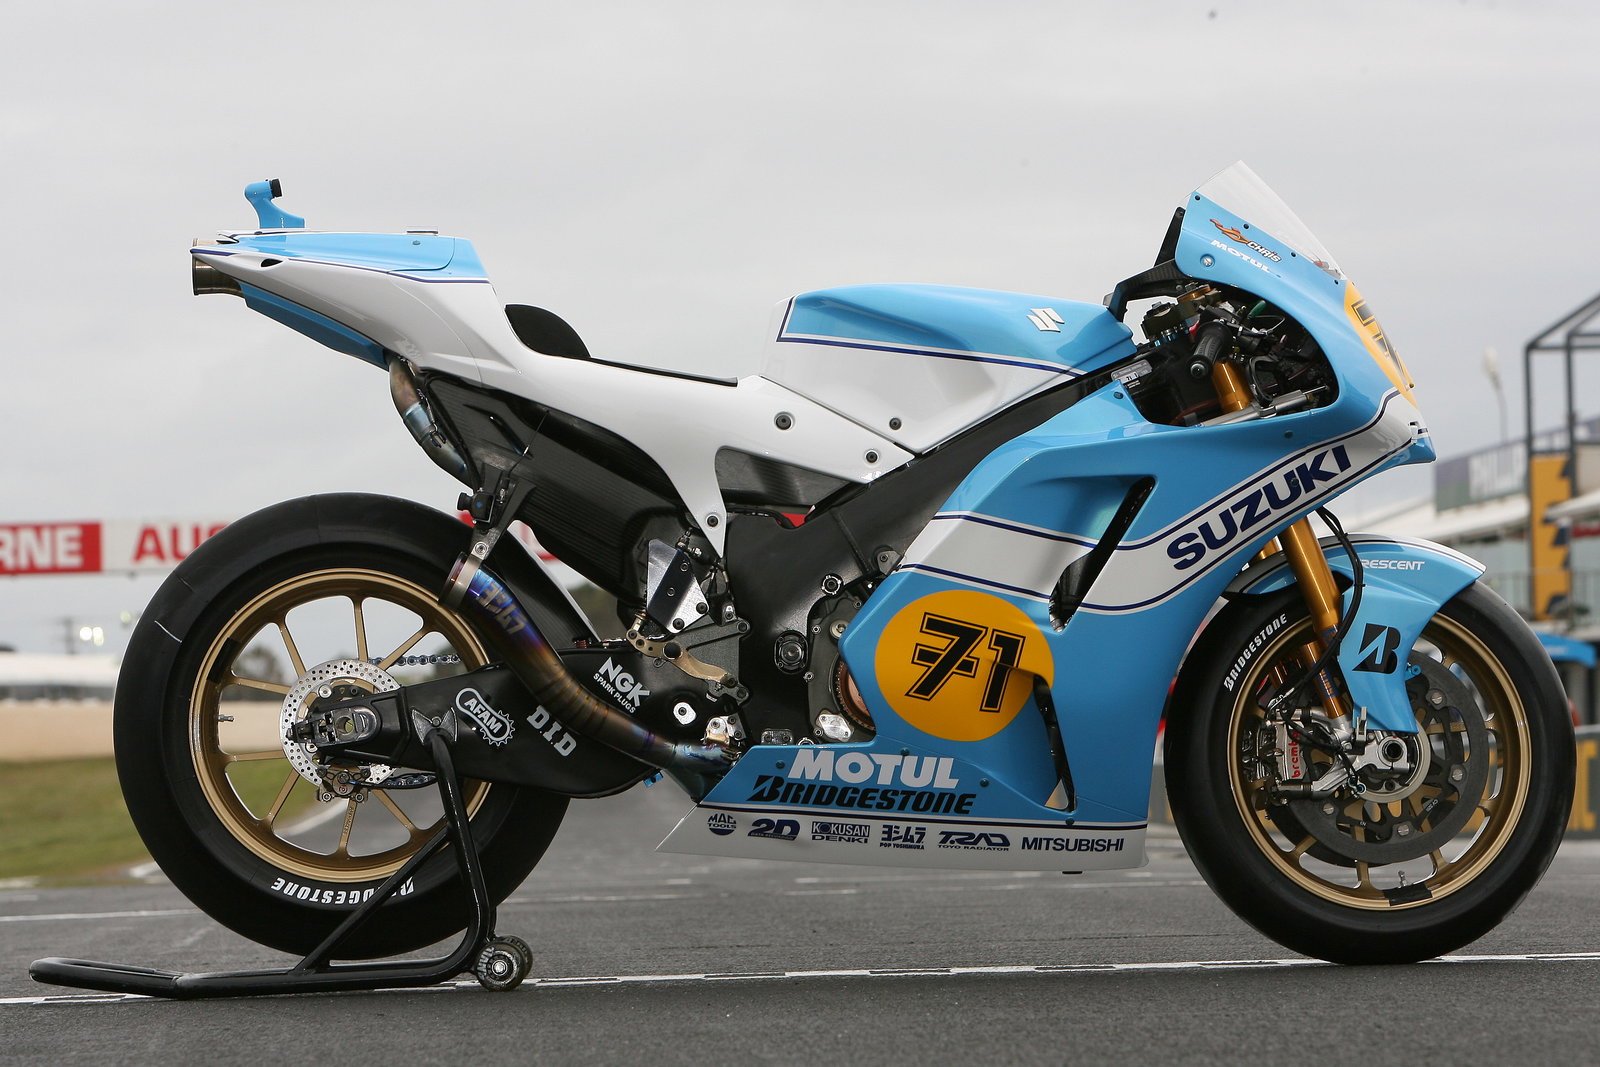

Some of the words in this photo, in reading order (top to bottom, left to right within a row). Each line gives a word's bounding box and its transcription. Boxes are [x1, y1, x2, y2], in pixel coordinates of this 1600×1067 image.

[1210, 240, 1271, 273] MOTUL
[1166, 444, 1352, 571] SUZUKI
[1360, 559, 1425, 571] RESCENT
[904, 611, 1026, 713] 71
[1223, 613, 1288, 692] BRIDGESTONE
[593, 672, 615, 695] SPARK
[613, 693, 637, 714] PLUGS
[599, 656, 650, 708] NGK
[464, 697, 503, 734] AFAM
[787, 748, 960, 790] MOTUL
[745, 775, 977, 815] BRIDGESTONE
[749, 818, 801, 836] 2D
[811, 821, 871, 838] KOKUSAN
[812, 835, 869, 844] DENKI
[1021, 836, 1125, 852] MITSUBISHI
[879, 842, 892, 850] POP
